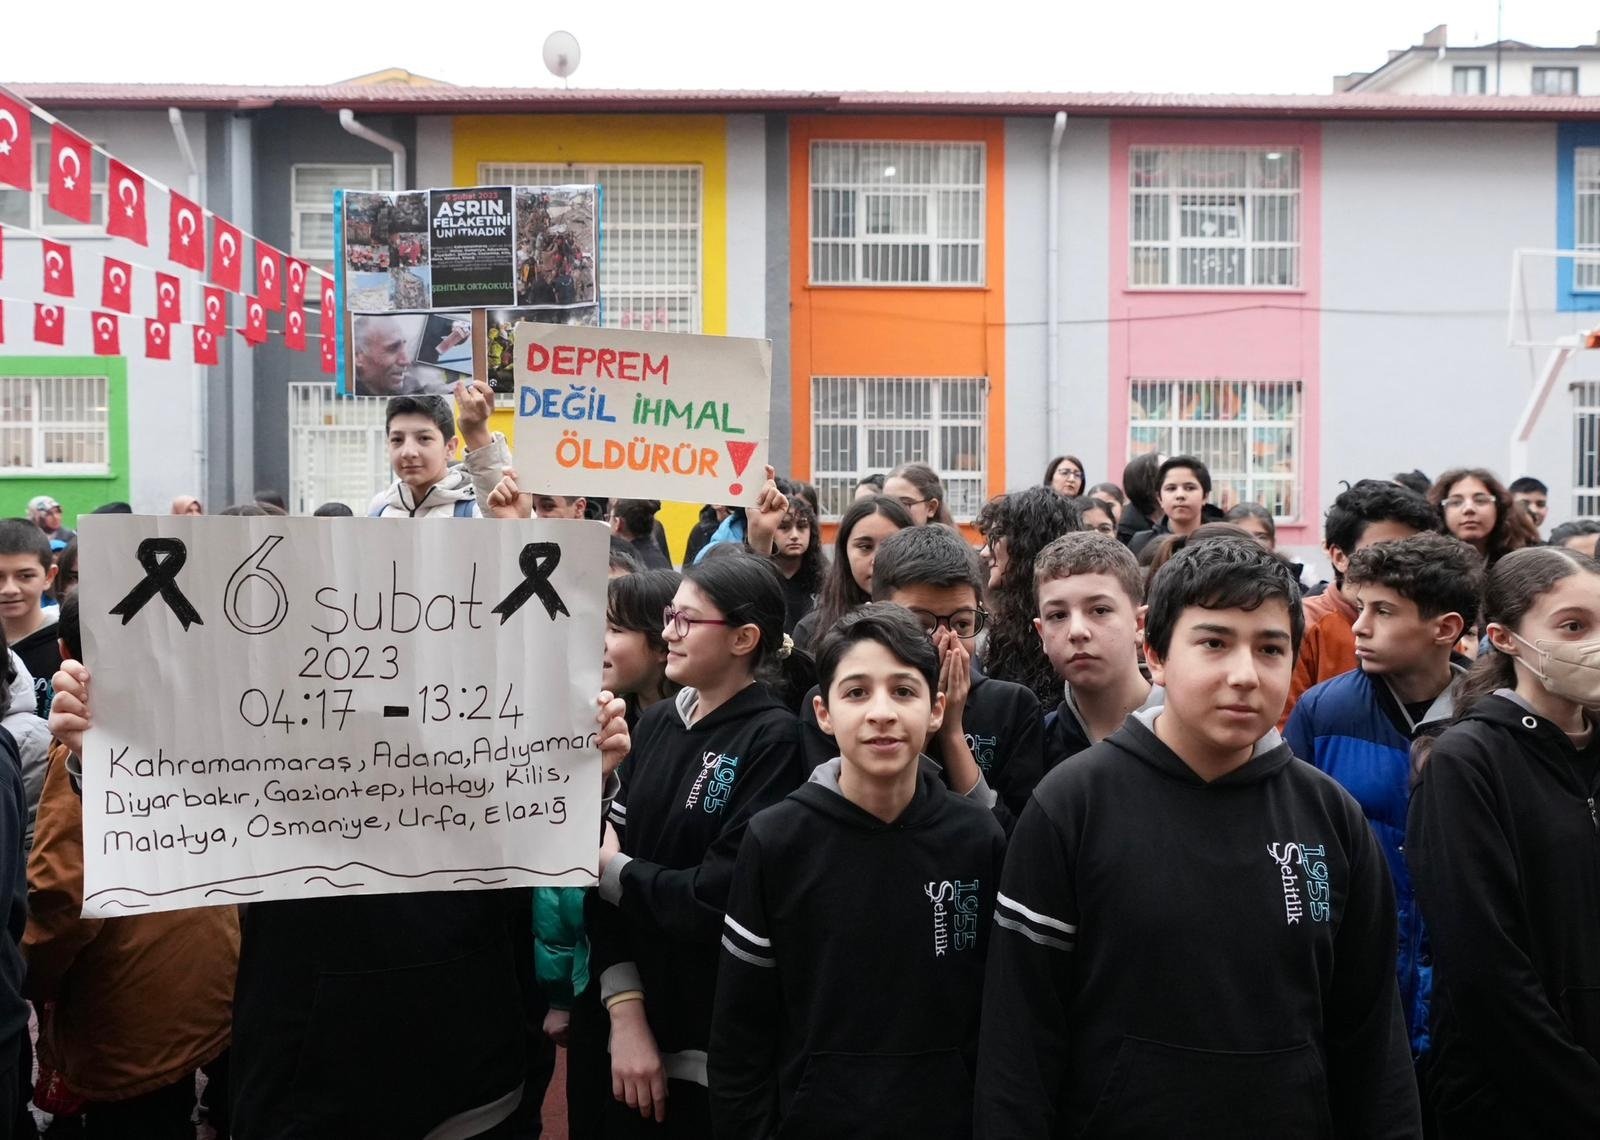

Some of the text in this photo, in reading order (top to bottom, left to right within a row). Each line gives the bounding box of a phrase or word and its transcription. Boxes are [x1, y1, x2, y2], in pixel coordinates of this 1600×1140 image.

[437, 199, 504, 217] ASRIN
[527, 342, 670, 385] DEPREM
[519, 383, 745, 434] DEĞİL İHMAL
[224, 535, 288, 635] 6
[299, 645, 399, 681] 2023
[239, 687, 356, 734] 04:17
[418, 683, 524, 729] 13:24
[412, 774, 495, 798] Hatay,
[506, 766, 570, 788] Kilis,
[703, 753, 738, 815] 1955
[103, 824, 238, 855] Malatya,
[247, 814, 391, 840] Osmaniye,
[399, 805, 475, 832] Urfa,
[1298, 844, 1330, 922] 1955
[954, 879, 979, 951] 1955
